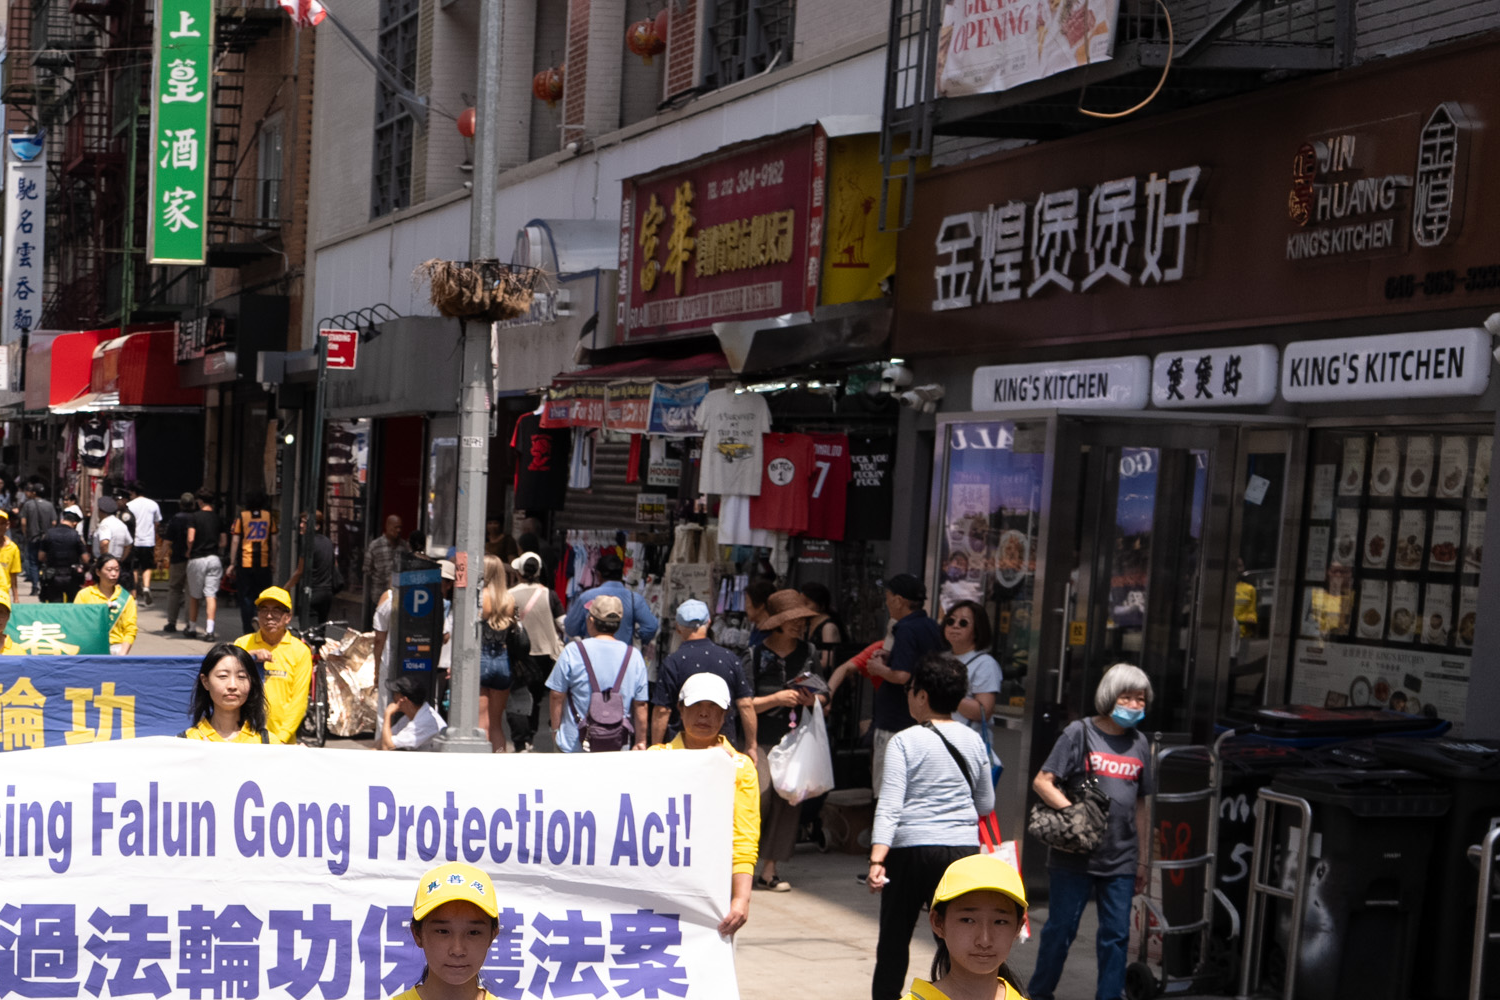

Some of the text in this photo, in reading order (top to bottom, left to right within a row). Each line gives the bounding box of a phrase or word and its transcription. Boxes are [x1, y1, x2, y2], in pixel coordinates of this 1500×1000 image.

[954, 4, 1031, 54] OPENNG
[1321, 135, 1356, 174] JIN
[1317, 176, 1397, 221] HUANG
[1331, 219, 1394, 253] KITCHEN
[1289, 346, 1465, 387] KING'S KITCHEN
[993, 372, 1108, 403] KING'S KITCHEN
[812, 461, 831, 499] 7
[246, 521, 268, 541] 26
[413, 590, 429, 613] P
[1090, 753, 1142, 777] Bronx
[92, 781, 216, 857] Falun
[233, 780, 350, 876] Gong
[368, 785, 596, 866] Protection
[610, 793, 691, 867] Act!
